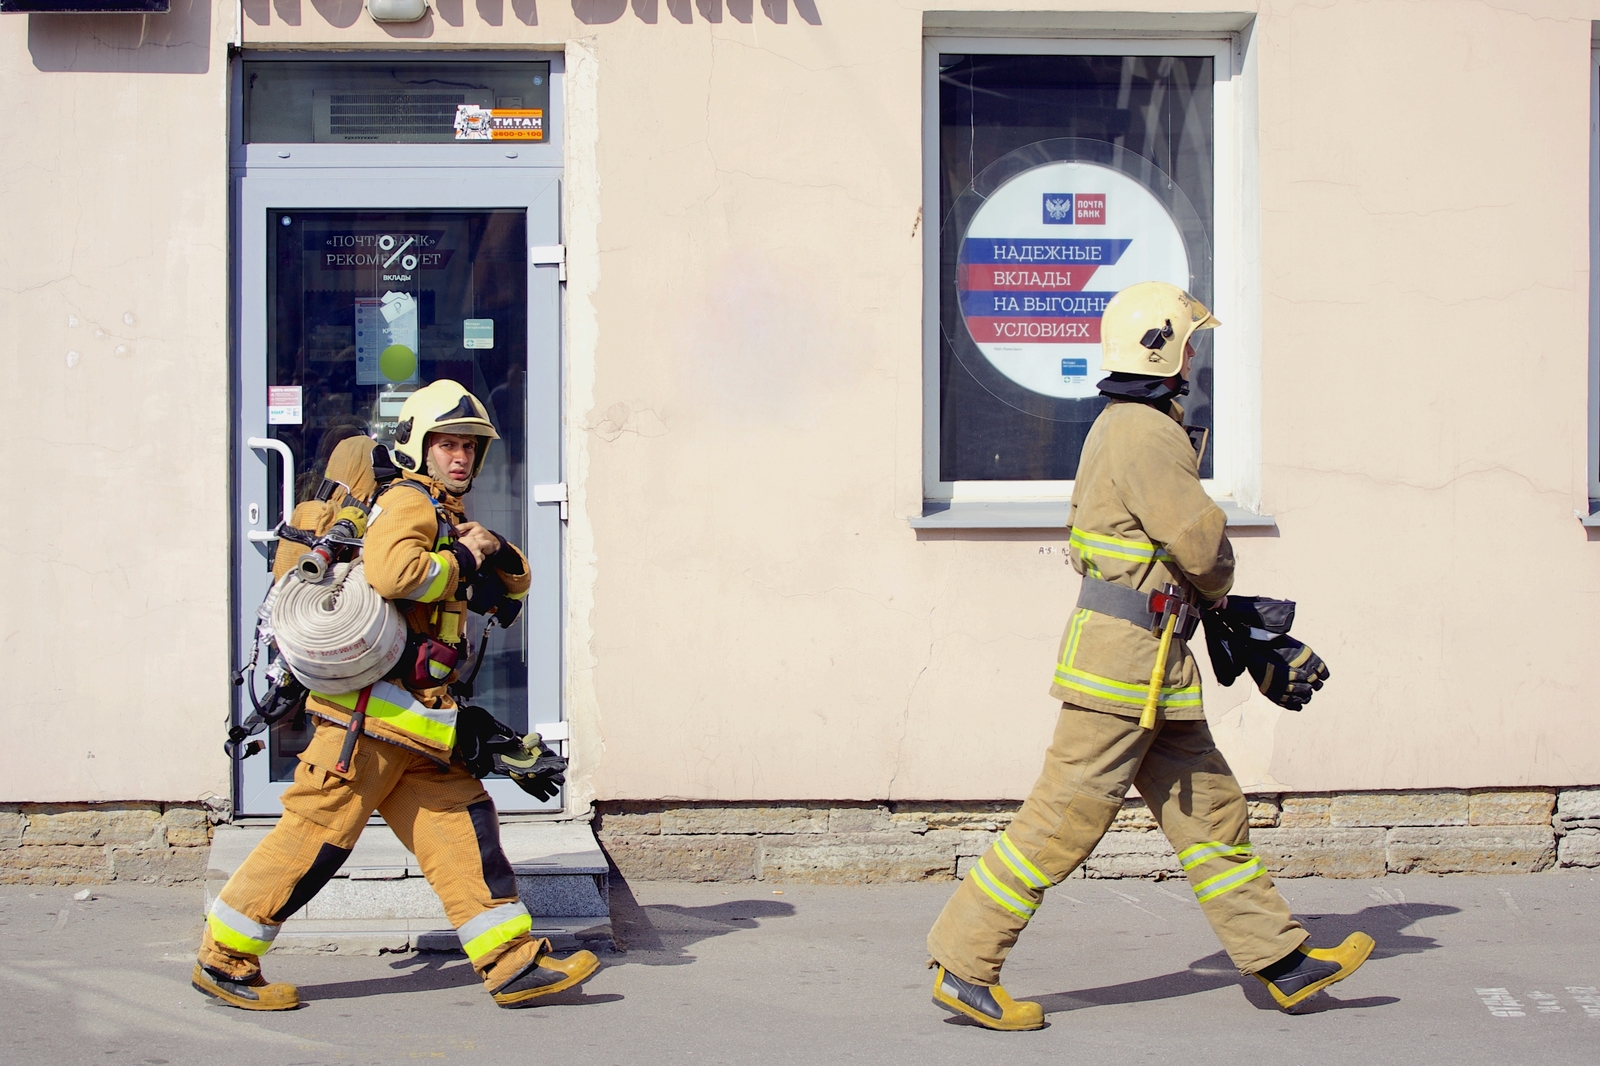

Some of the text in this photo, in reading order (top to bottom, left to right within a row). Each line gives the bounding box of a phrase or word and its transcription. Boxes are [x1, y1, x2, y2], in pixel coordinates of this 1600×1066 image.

[493, 118, 542, 126] ТИТАН
[1077, 200, 1104, 209] ПОЧТА
[1077, 210, 1101, 218] БАНК
[326, 254, 441, 266] РЕКОМЕНЕТ
[993, 245, 1102, 262] НАДЕЖНЫЕ
[993, 271, 1072, 288] ВКЛАДЫ
[993, 297, 1020, 311] НА
[993, 322, 1090, 337] УСЛОВИЯХ
